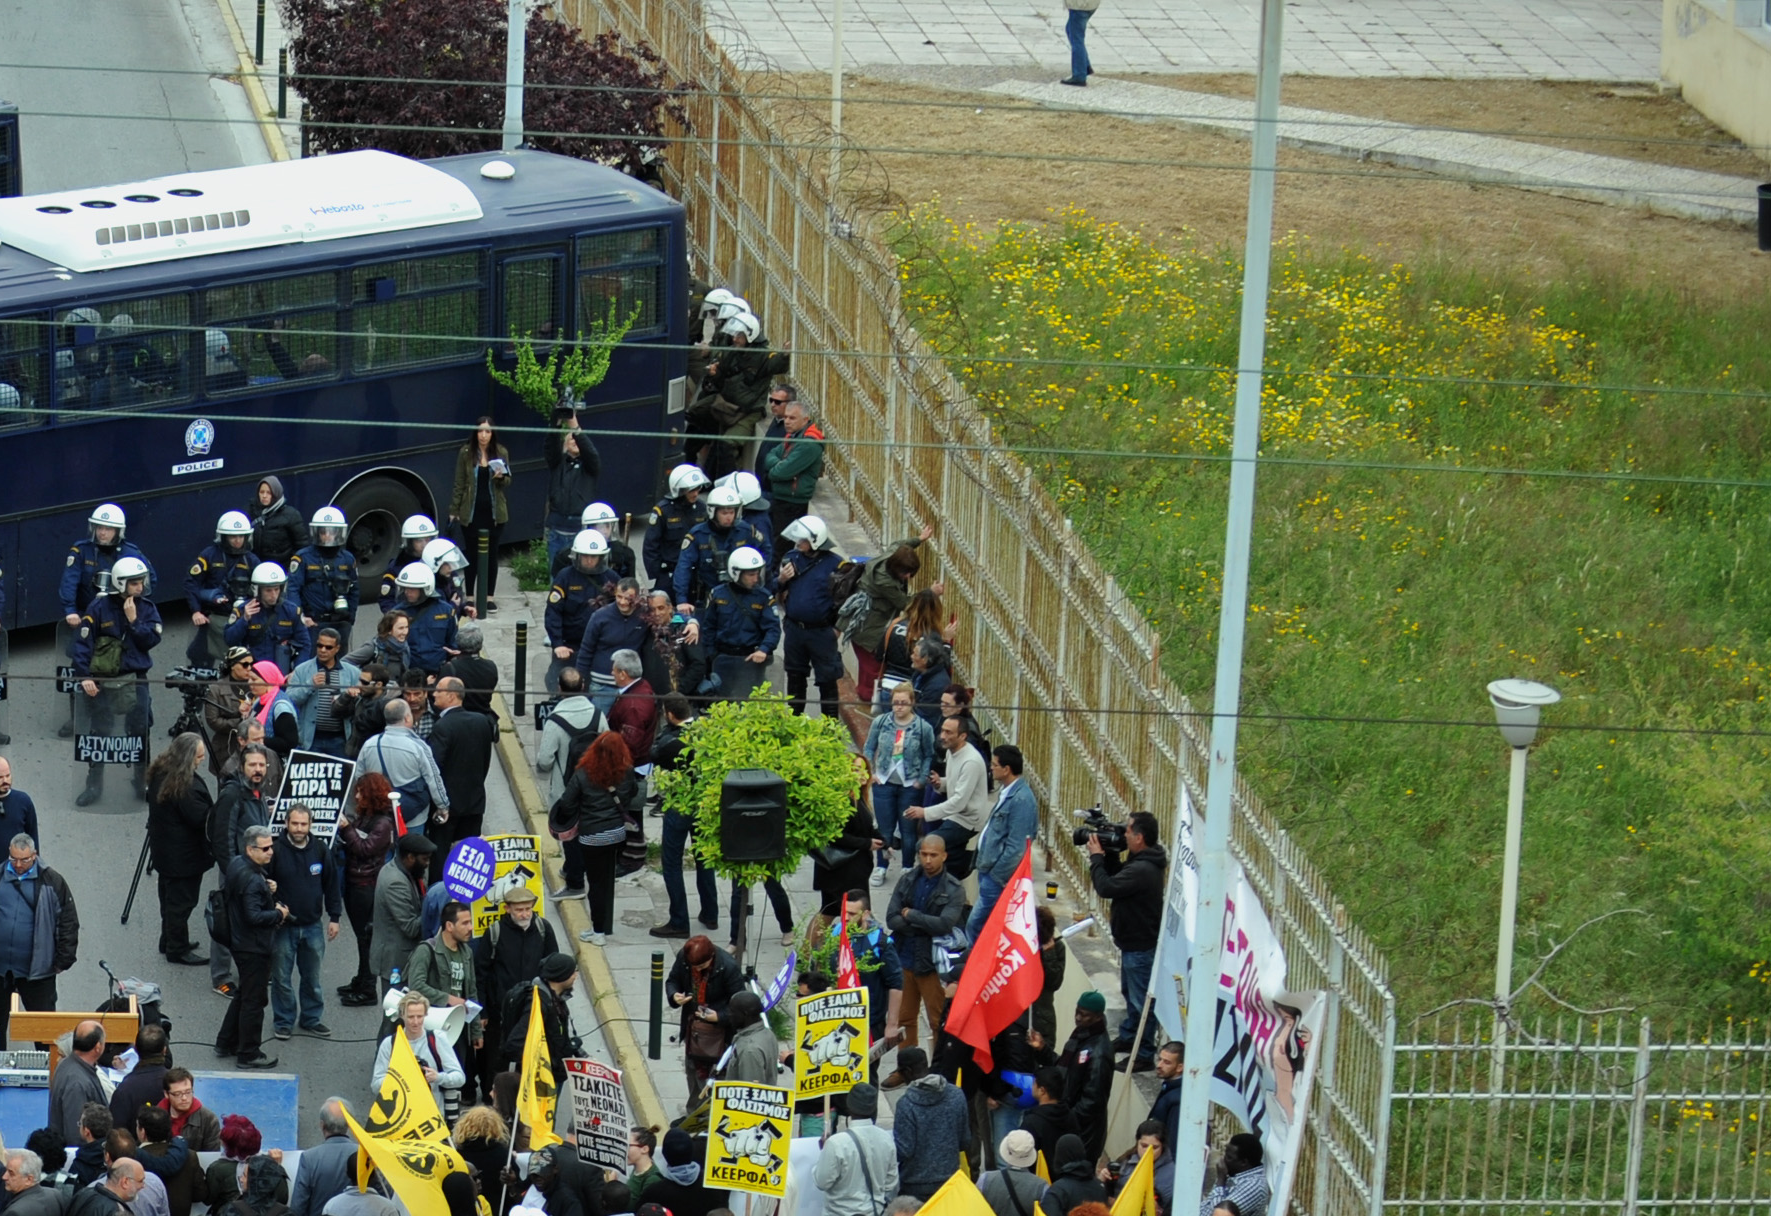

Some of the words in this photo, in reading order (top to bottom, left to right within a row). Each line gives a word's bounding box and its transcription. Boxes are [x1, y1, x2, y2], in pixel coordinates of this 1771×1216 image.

[309, 203, 364, 215] Webasto
[178, 460, 218, 472] POLICE
[78, 735, 143, 751] ΑΣΤΥΝΟΜΙΑ
[80, 750, 140, 763] POLICE
[289, 762, 343, 780] ΚΛΕΙΣΤΕ
[291, 779, 328, 797] ΤΩΡΑ
[330, 779, 342, 790] ΤΑ
[503, 838, 533, 850] ΞΑΝΑ
[457, 844, 486, 871] ΕΞΩ
[494, 850, 538, 862] ΑΣΙΣΜΟΣ
[447, 862, 488, 891] ΝΕΟΝΑΖΙ
[801, 998, 826, 1016] ΠΟΤΕ
[828, 992, 860, 1008] ΞΑΝΑ
[808, 1006, 865, 1023] ΦΑΣΙΣΜΟΣ
[572, 1074, 624, 1103] ΤΣΑΚΙΣΤΕ
[800, 1072, 851, 1091] ΚΕΕΡΦΑ
[718, 1086, 749, 1100] ΠΟΤΕ
[751, 1089, 785, 1104] ΞΑΝΑ
[574, 1095, 589, 1108] ΤΟΥΣ
[590, 1095, 627, 1118] ΝΕΟΝΑΖΙ
[727, 1099, 790, 1120] ΦΑΣΙΣΜΟΣ
[712, 1166, 769, 1186] ΚΕΕΡΦΑ
